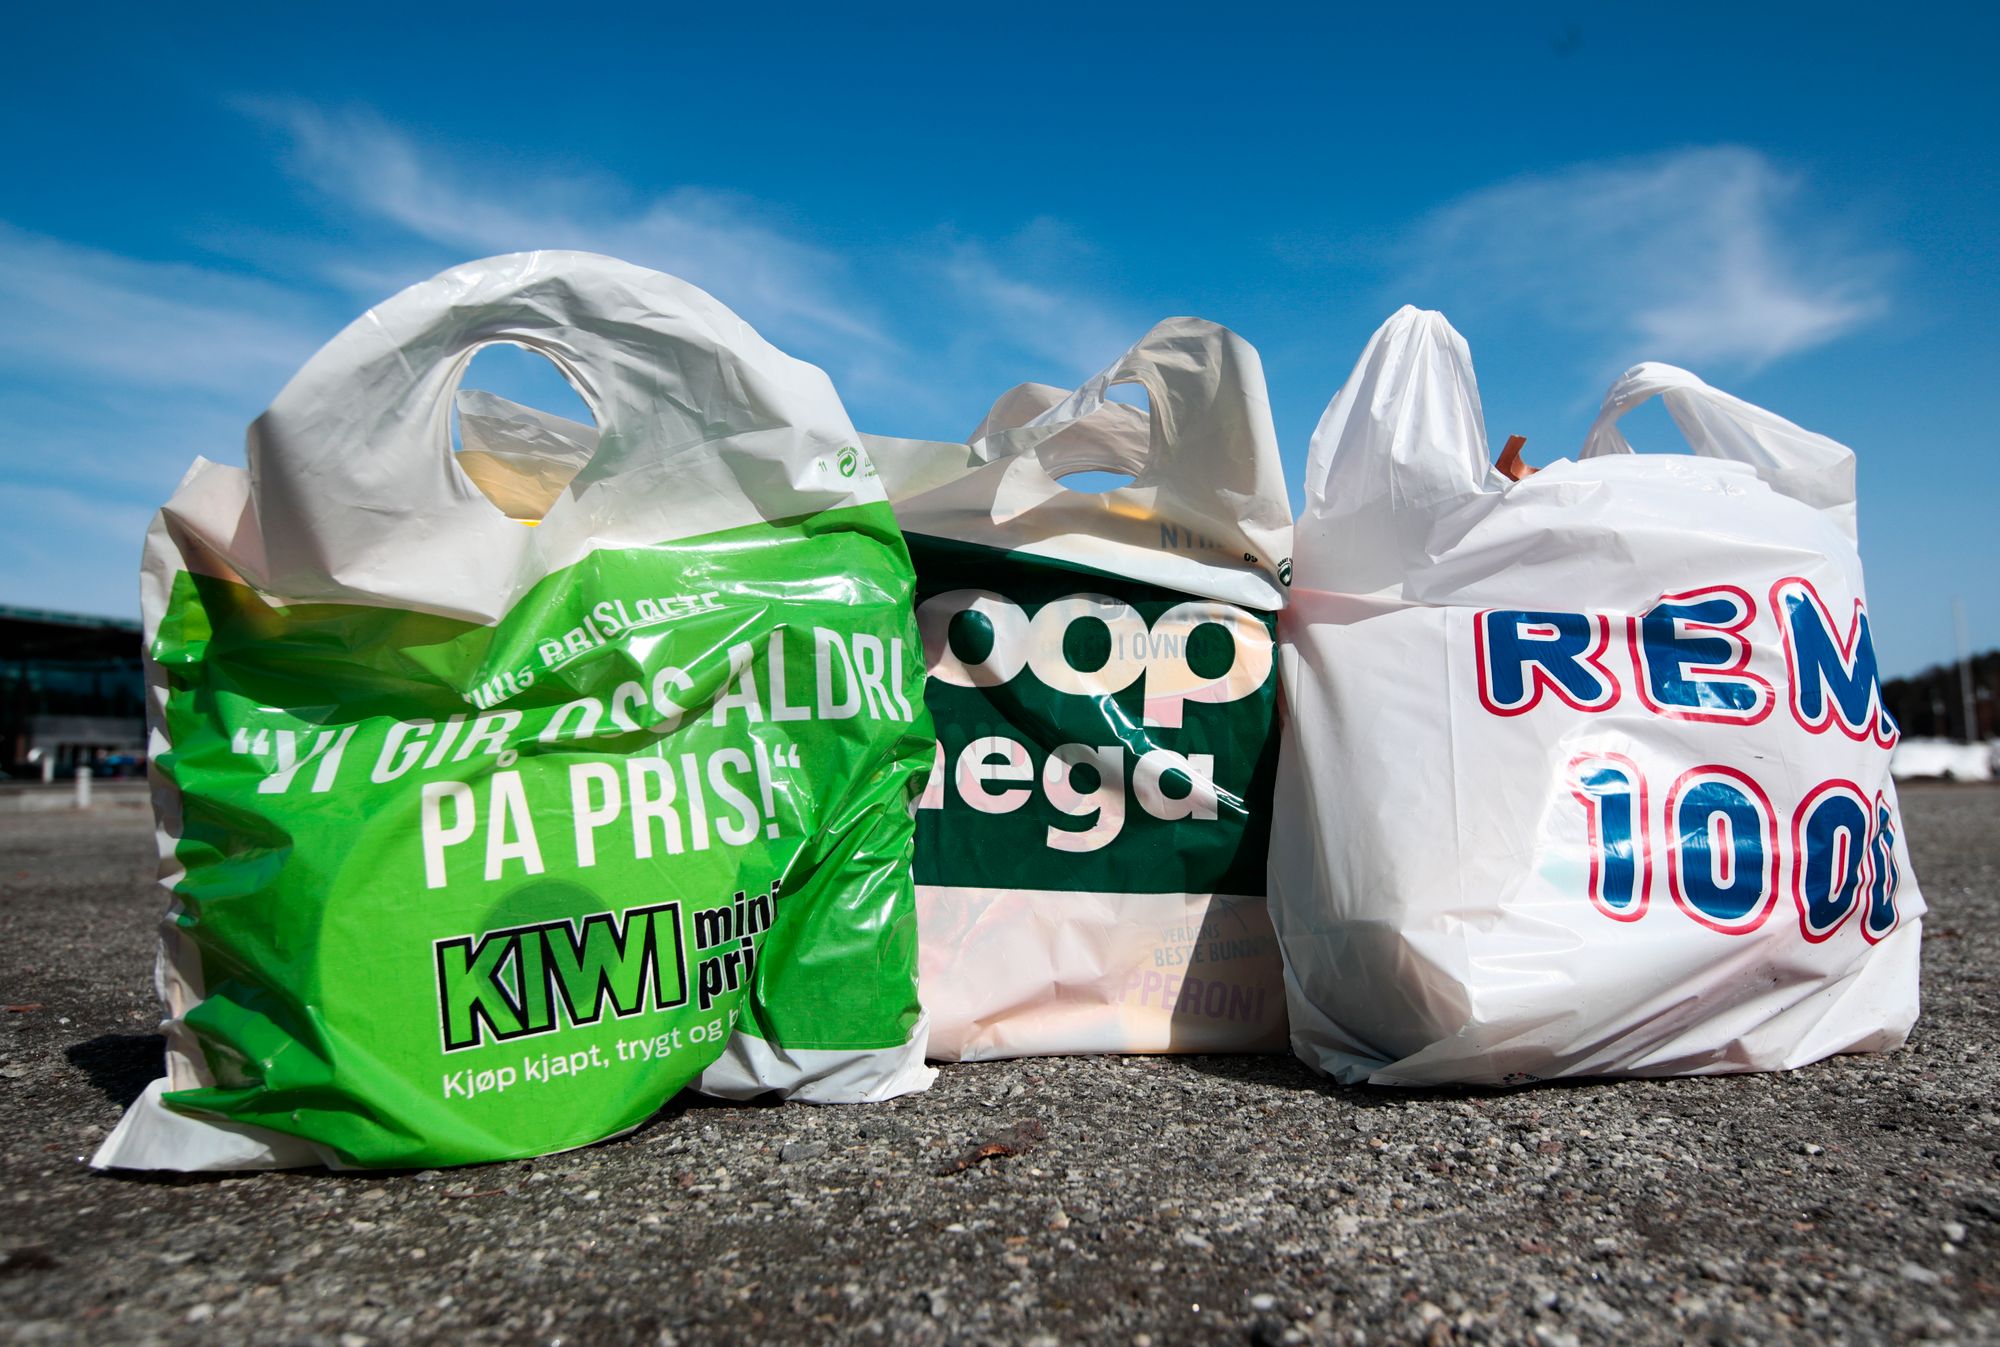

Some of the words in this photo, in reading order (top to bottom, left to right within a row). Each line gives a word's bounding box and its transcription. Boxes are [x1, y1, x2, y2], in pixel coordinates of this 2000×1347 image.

[370, 709, 524, 785] GIR
[711, 625, 914, 728] ALDRI
[915, 588, 1274, 729] oop
[1473, 576, 1901, 750] REM
[420, 748, 545, 890] PÅ
[1567, 750, 1901, 945] 1000
[432, 899, 691, 1056] KIWI
[697, 935, 758, 1012] pri
[442, 1062, 518, 1101] Kjøp
[523, 1042, 611, 1086] kjapt,
[615, 1028, 684, 1063] trygt
[688, 1017, 724, 1043] og
